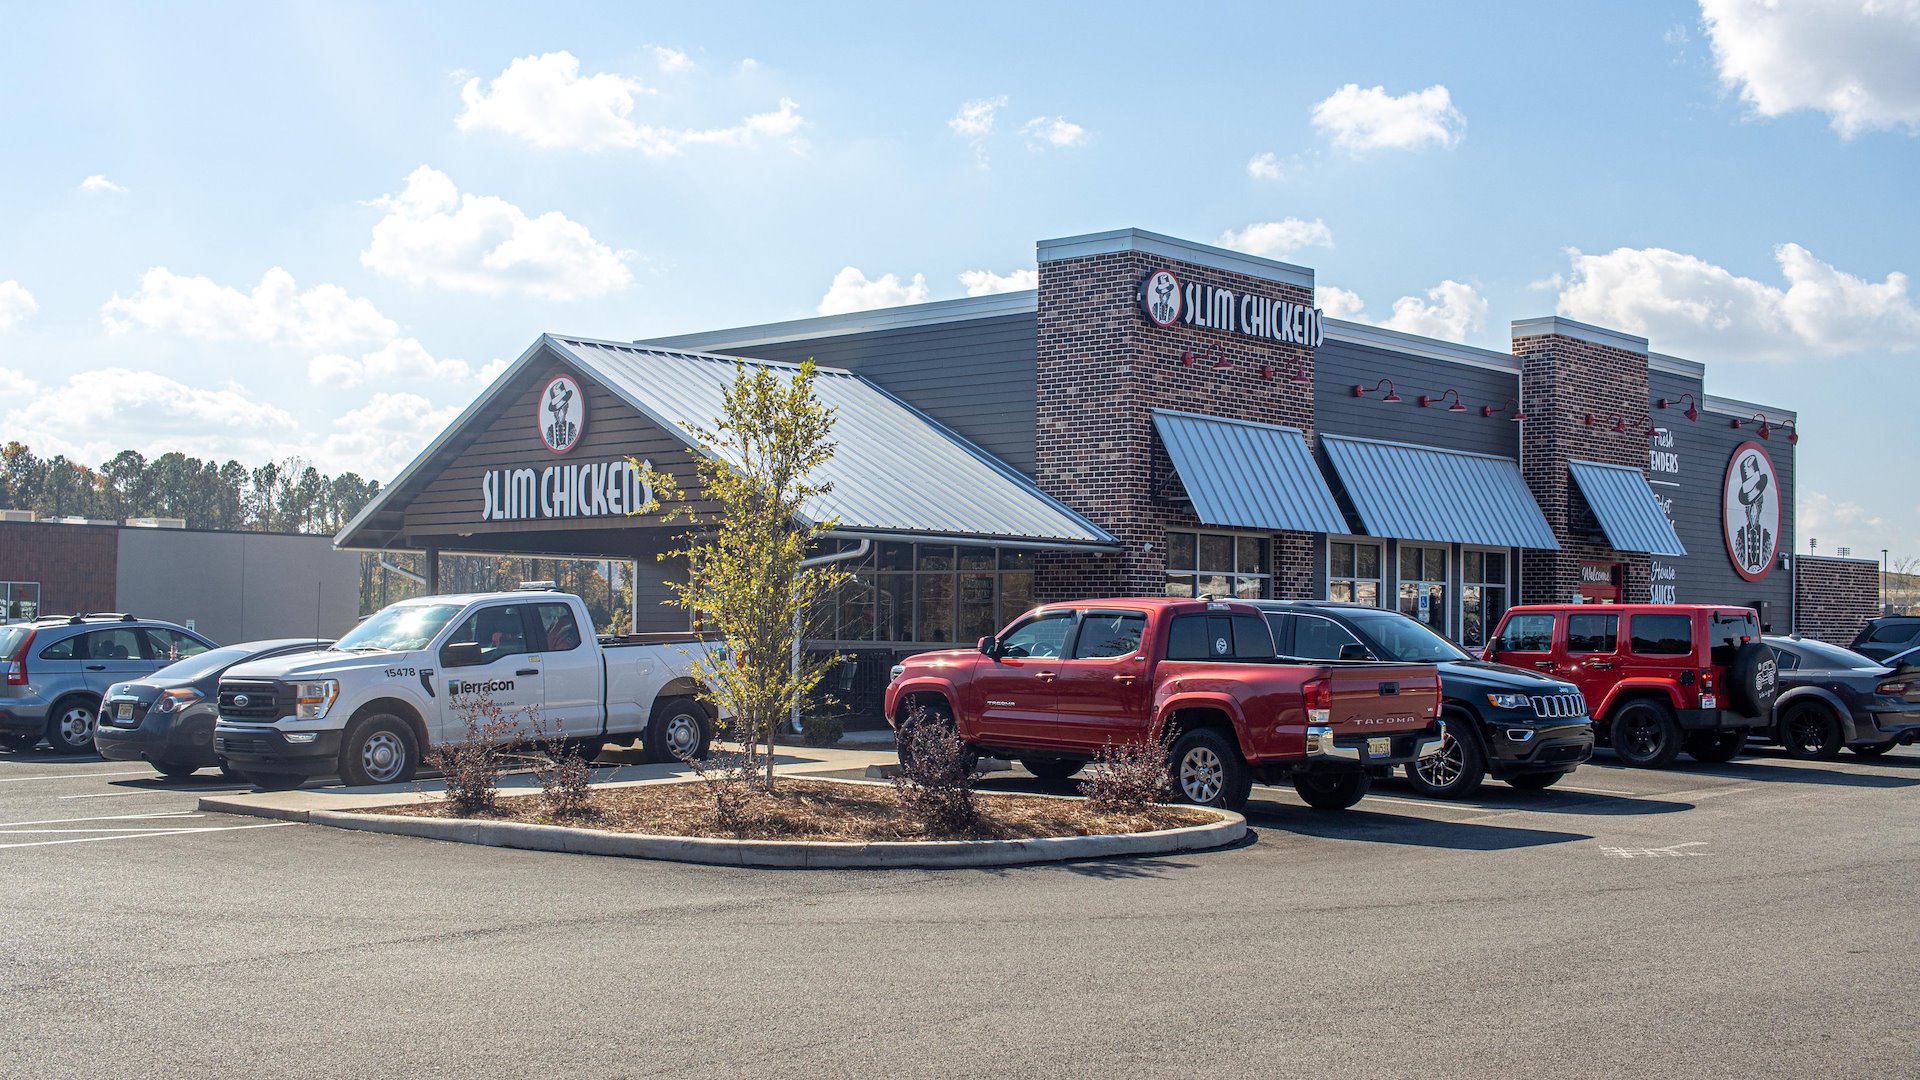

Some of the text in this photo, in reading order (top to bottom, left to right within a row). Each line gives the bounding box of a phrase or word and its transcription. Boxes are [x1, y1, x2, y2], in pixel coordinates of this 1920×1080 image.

[1185, 281, 1324, 348] SLIM CHICKENS
[482, 458, 654, 521] SLIM CHICKENS
[1581, 566, 1610, 582] Welcome
[1650, 561, 1676, 581] House
[1650, 584, 1676, 604] SAUCES
[384, 667, 416, 678] 15478
[460, 679, 515, 694] Terracon
[1353, 716, 1415, 726] TACOMA
